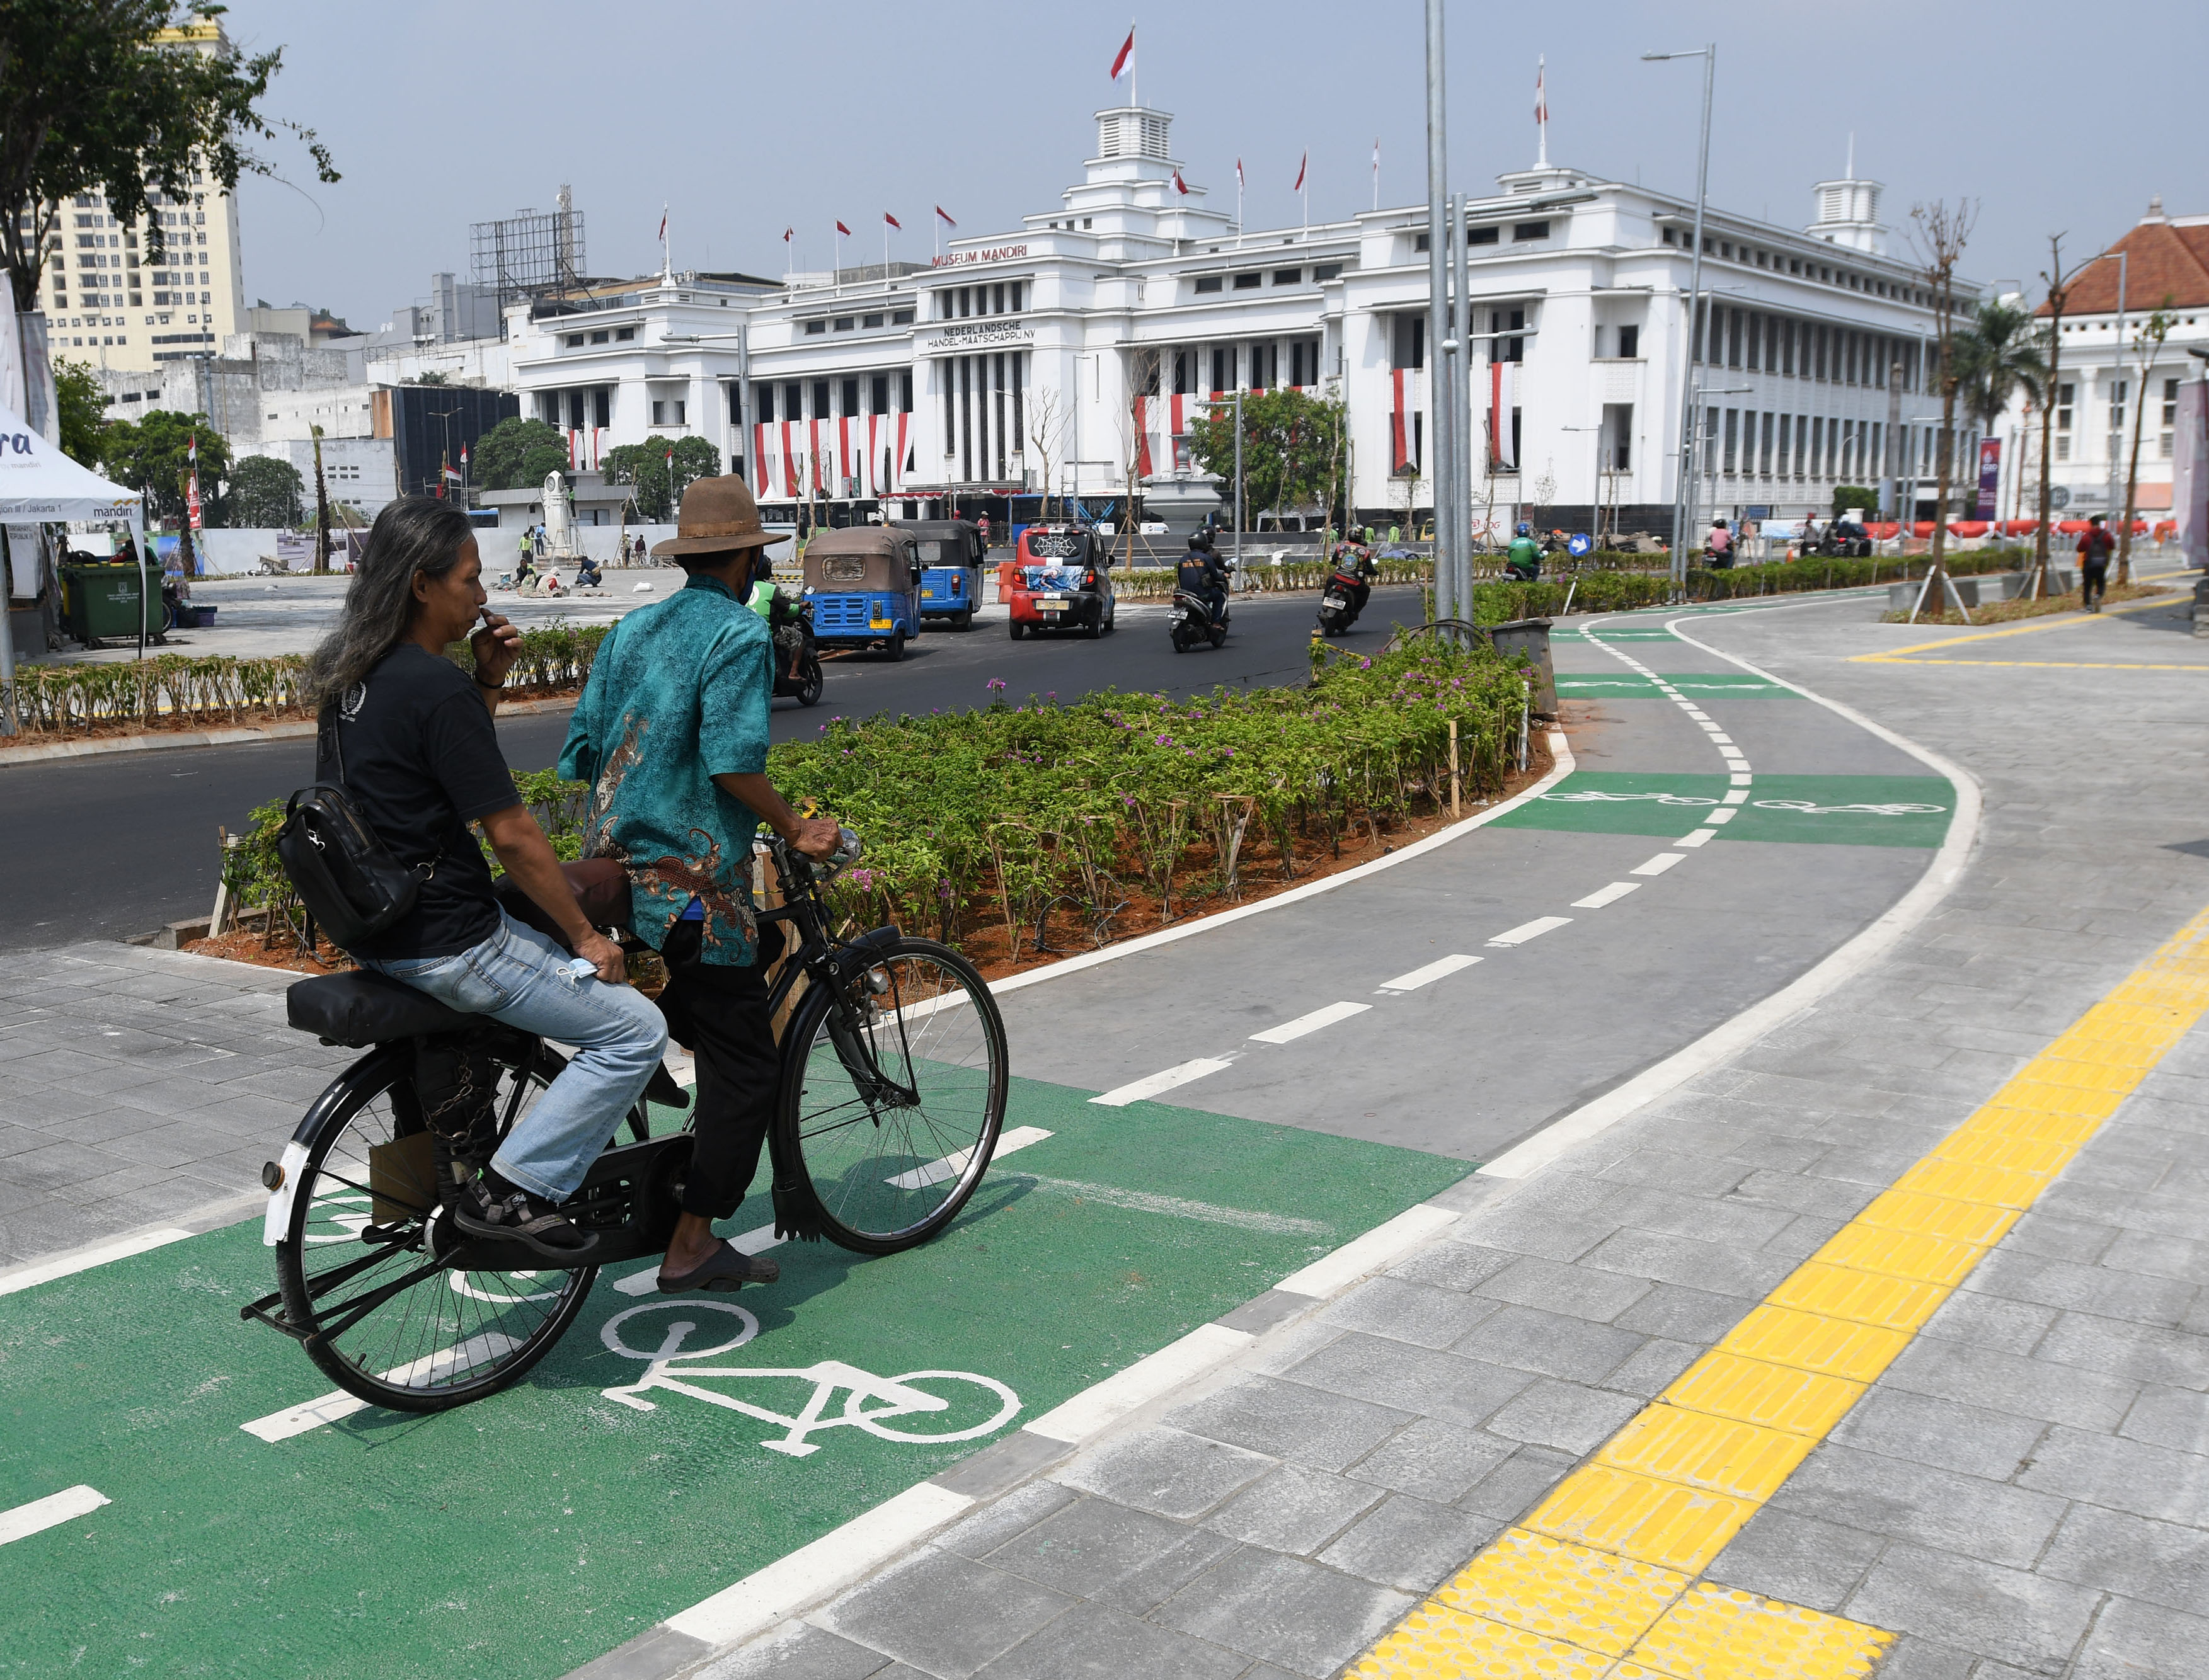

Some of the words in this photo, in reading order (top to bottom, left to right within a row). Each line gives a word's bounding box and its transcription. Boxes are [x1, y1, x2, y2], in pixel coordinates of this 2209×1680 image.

[932, 251, 977, 268] MUSEUM
[981, 244, 1027, 261] MANDIRI
[944, 321, 1021, 337] NEDERLANDSCHE
[28, 504, 55, 513] Jakarta
[93, 505, 132, 517] mandiri
